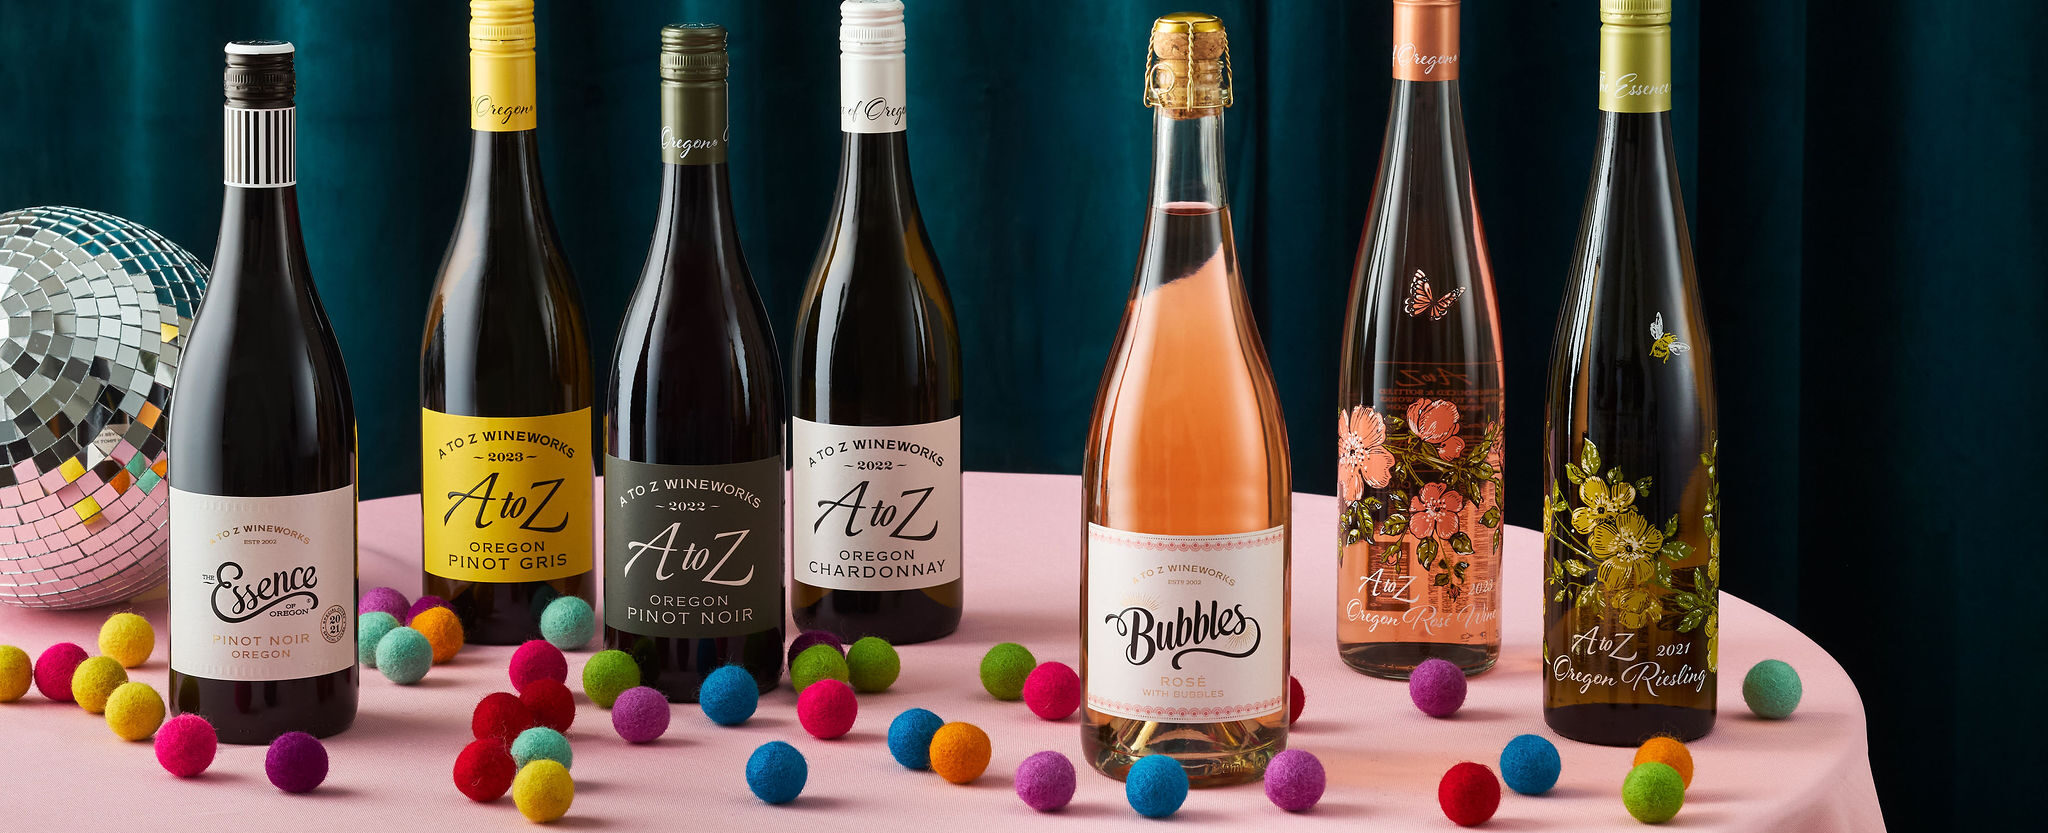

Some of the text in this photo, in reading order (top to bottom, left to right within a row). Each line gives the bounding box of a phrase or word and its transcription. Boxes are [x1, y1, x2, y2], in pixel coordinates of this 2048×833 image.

[438, 430, 575, 459] A TO Z WINEWORKS
[487, 452, 524, 462] 2023
[808, 439, 945, 468] A TO Z WINEWORKS
[857, 460, 893, 471] 2022
[619, 478, 761, 509] A TO Z WINEWORKS
[668, 501, 706, 511] 2022
[216, 530, 230, 540] TO
[233, 526, 240, 535] Z
[243, 524, 311, 545] WINEWORKS
[469, 541, 545, 553] OREGON
[448, 553, 567, 570] PINOT GRIS
[839, 549, 915, 562] OREGON
[809, 559, 946, 579] CHARDONNAY
[1141, 568, 1154, 579] TO
[1157, 566, 1164, 575] Z
[1167, 564, 1236, 587] WINEWORKS
[211, 561, 319, 624] Essence
[650, 594, 728, 607] OREGON
[269, 608, 309, 617] OREGON
[627, 606, 753, 625] PINOT NOIR
[1346, 598, 1400, 632] Oregon
[1402, 604, 1453, 636] Rosé
[213, 633, 310, 646] PINOT NOIR
[1105, 600, 1262, 670] Bubbles
[231, 649, 291, 659] OREGON
[1655, 642, 1692, 657] 2021
[1160, 675, 1207, 688] ROSÉ
[1553, 654, 1707, 697] Oregon Riesling
[1142, 688, 1224, 698] WITH BUBBLES
